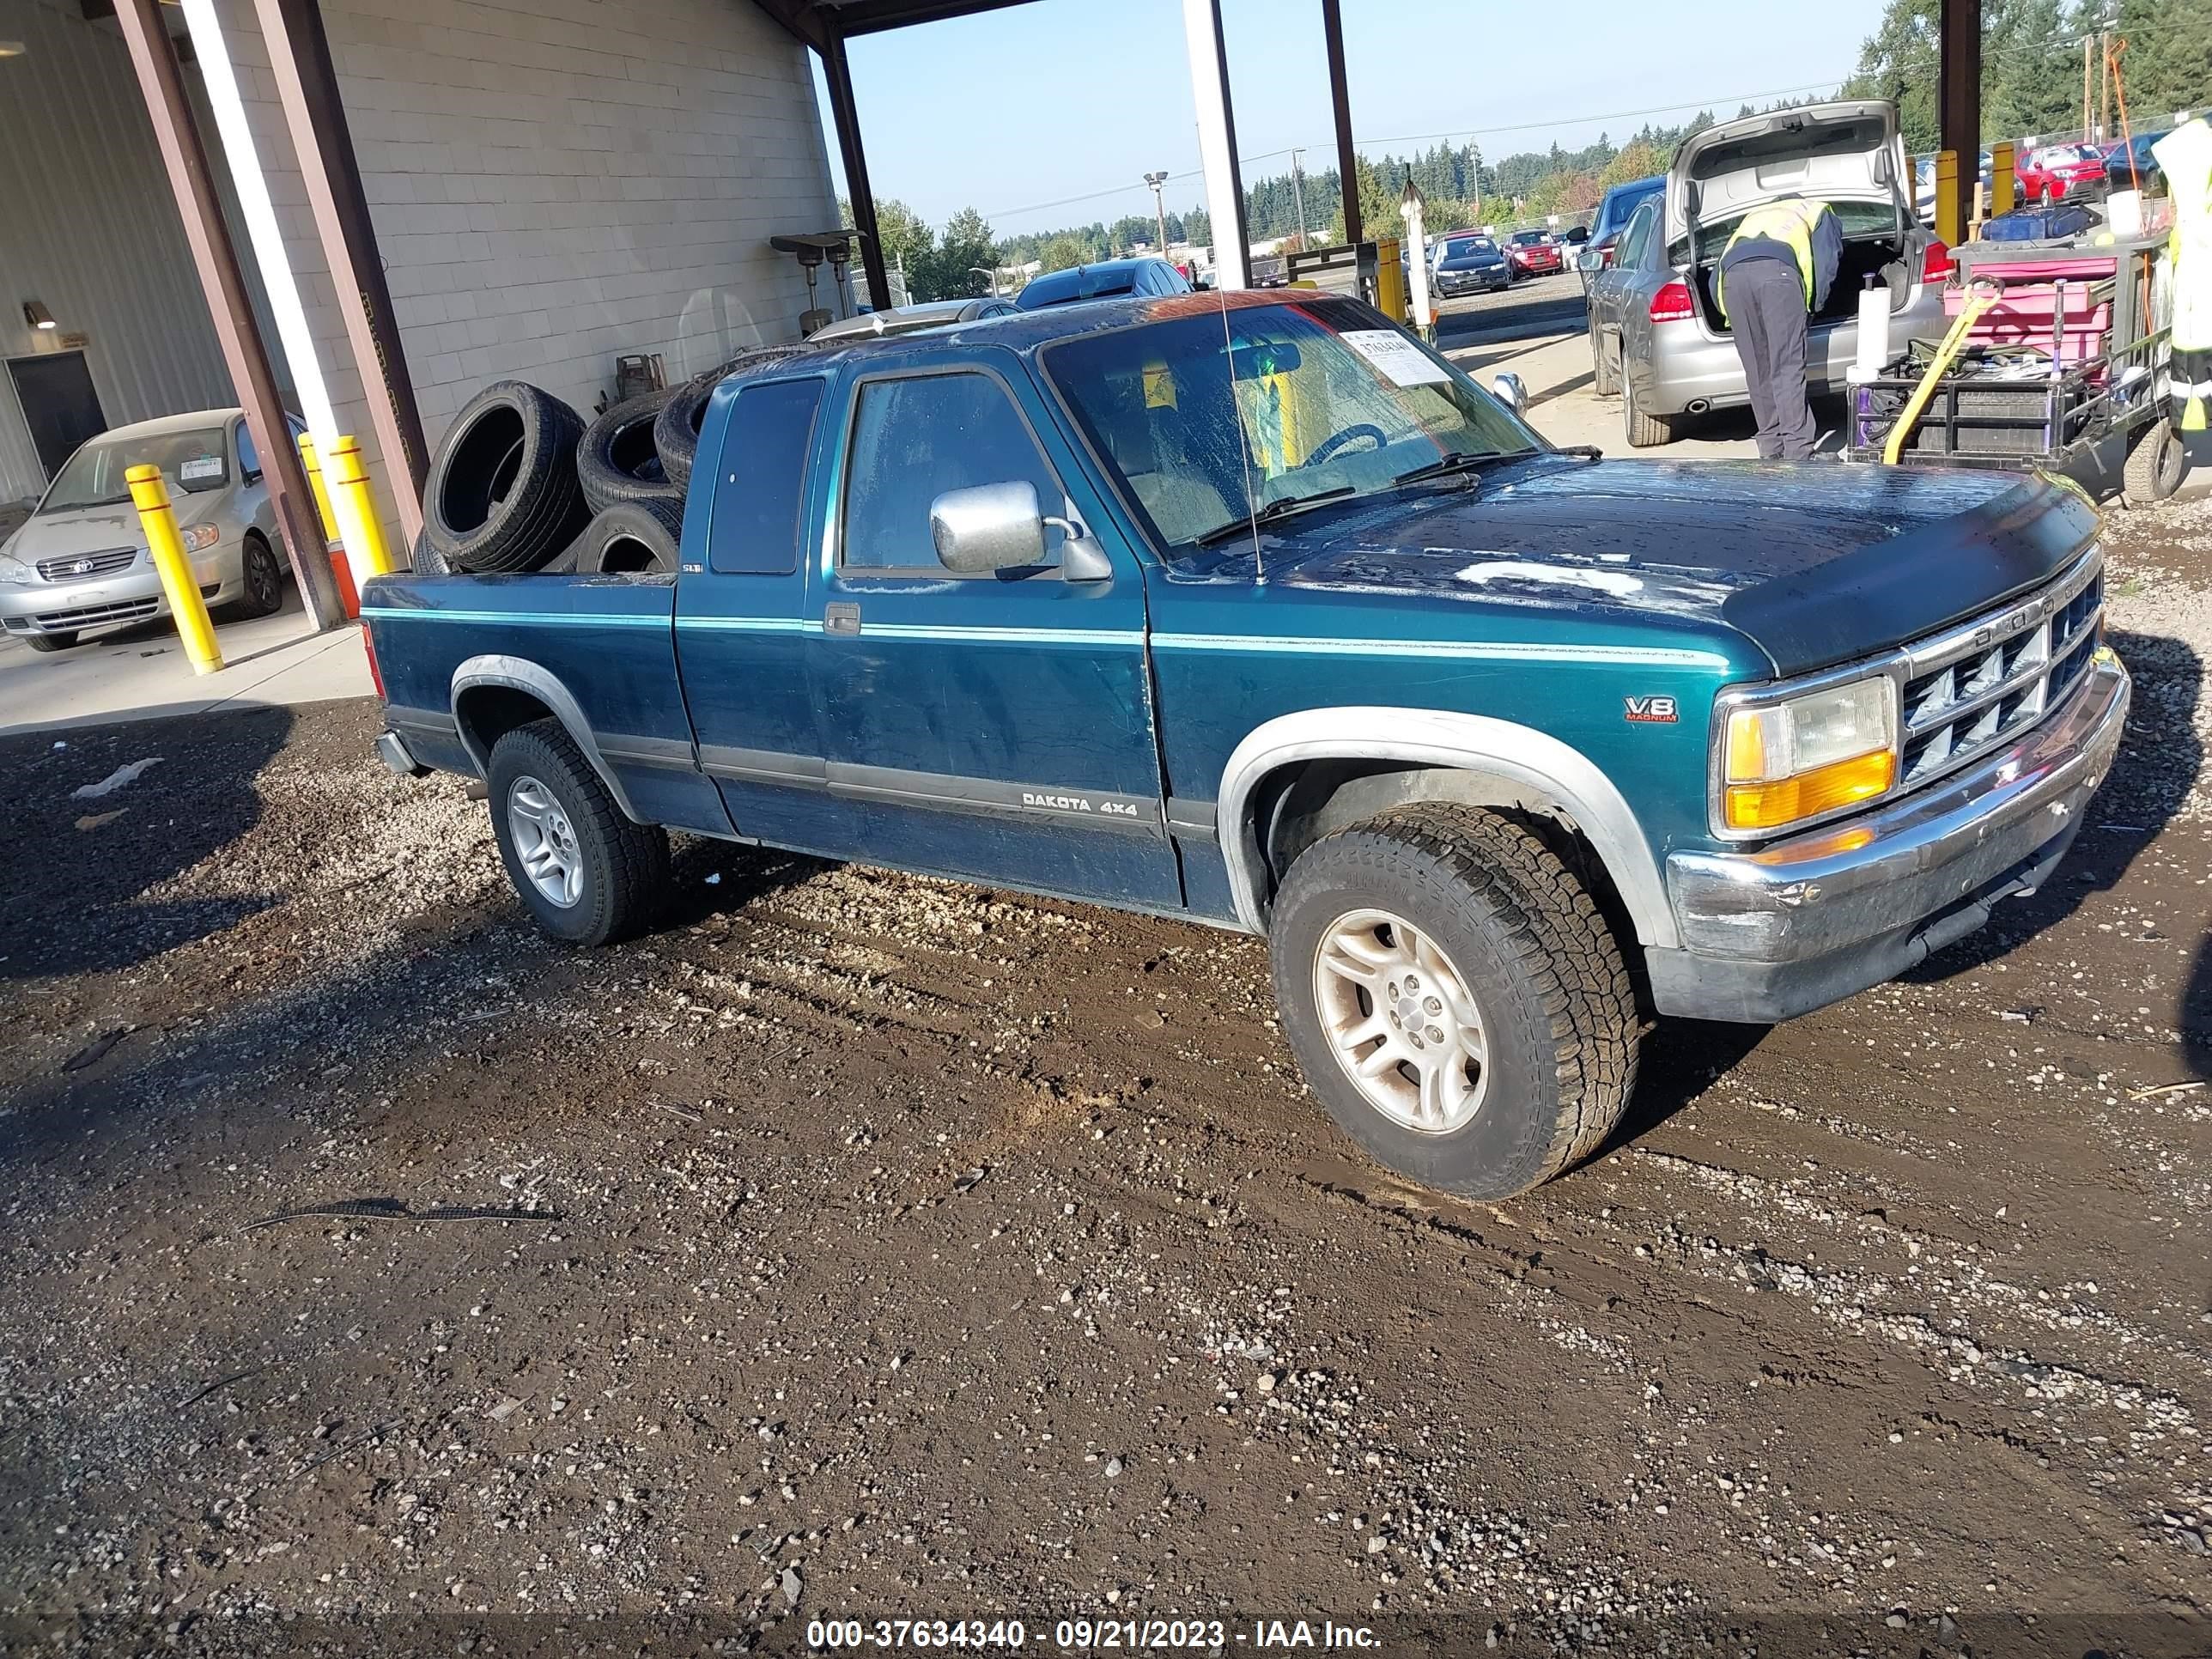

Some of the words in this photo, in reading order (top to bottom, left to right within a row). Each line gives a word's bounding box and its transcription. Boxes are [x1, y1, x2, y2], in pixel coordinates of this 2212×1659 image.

[1360, 340, 1412, 355] 37634340
[1623, 696, 1674, 714] V8
[1626, 714, 1677, 722] MAGNUM
[1023, 793, 1091, 811] DAKOTA
